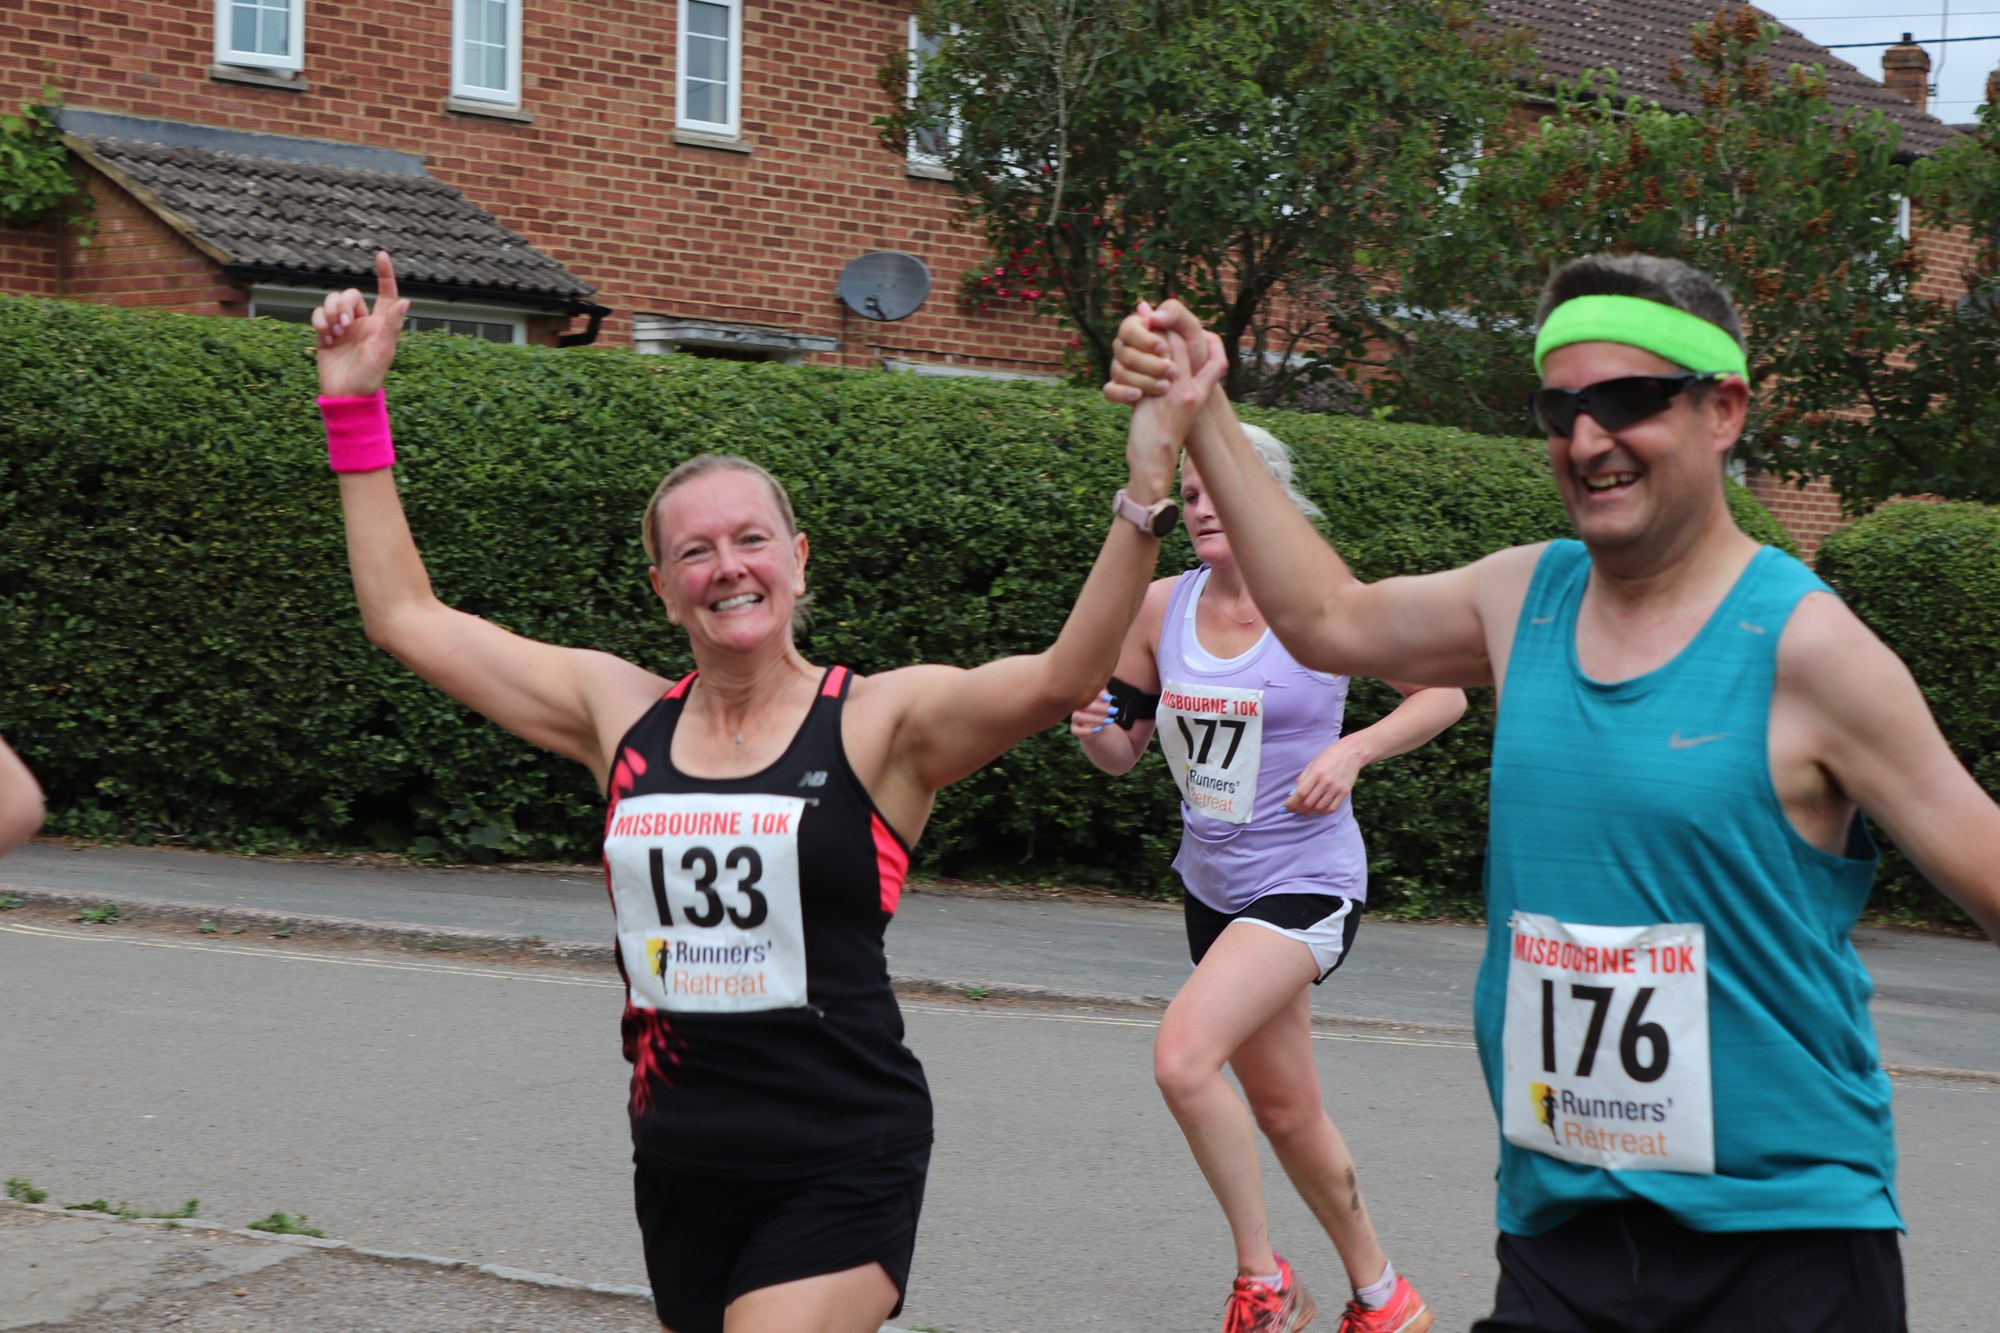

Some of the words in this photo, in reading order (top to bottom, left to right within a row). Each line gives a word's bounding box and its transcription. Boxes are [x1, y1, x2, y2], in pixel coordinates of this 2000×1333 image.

[1161, 690, 1228, 715] MISBOURNE
[1232, 700, 1259, 717] 10K
[1176, 715, 1247, 770] 177
[1189, 769, 1240, 794] Runners'
[1190, 788, 1233, 814] Retreat
[613, 812, 742, 837] MISBOURNE
[751, 813, 791, 835] 10K
[649, 846, 768, 930] 133
[675, 940, 772, 964] Runners'
[1513, 934, 1636, 974] MISBOURNE
[1648, 946, 1696, 974] 10K
[673, 970, 767, 996] Retreat
[1541, 978, 1670, 1083] 176
[1561, 1090, 1672, 1122] Runners'
[1564, 1121, 1669, 1157] Retreat
